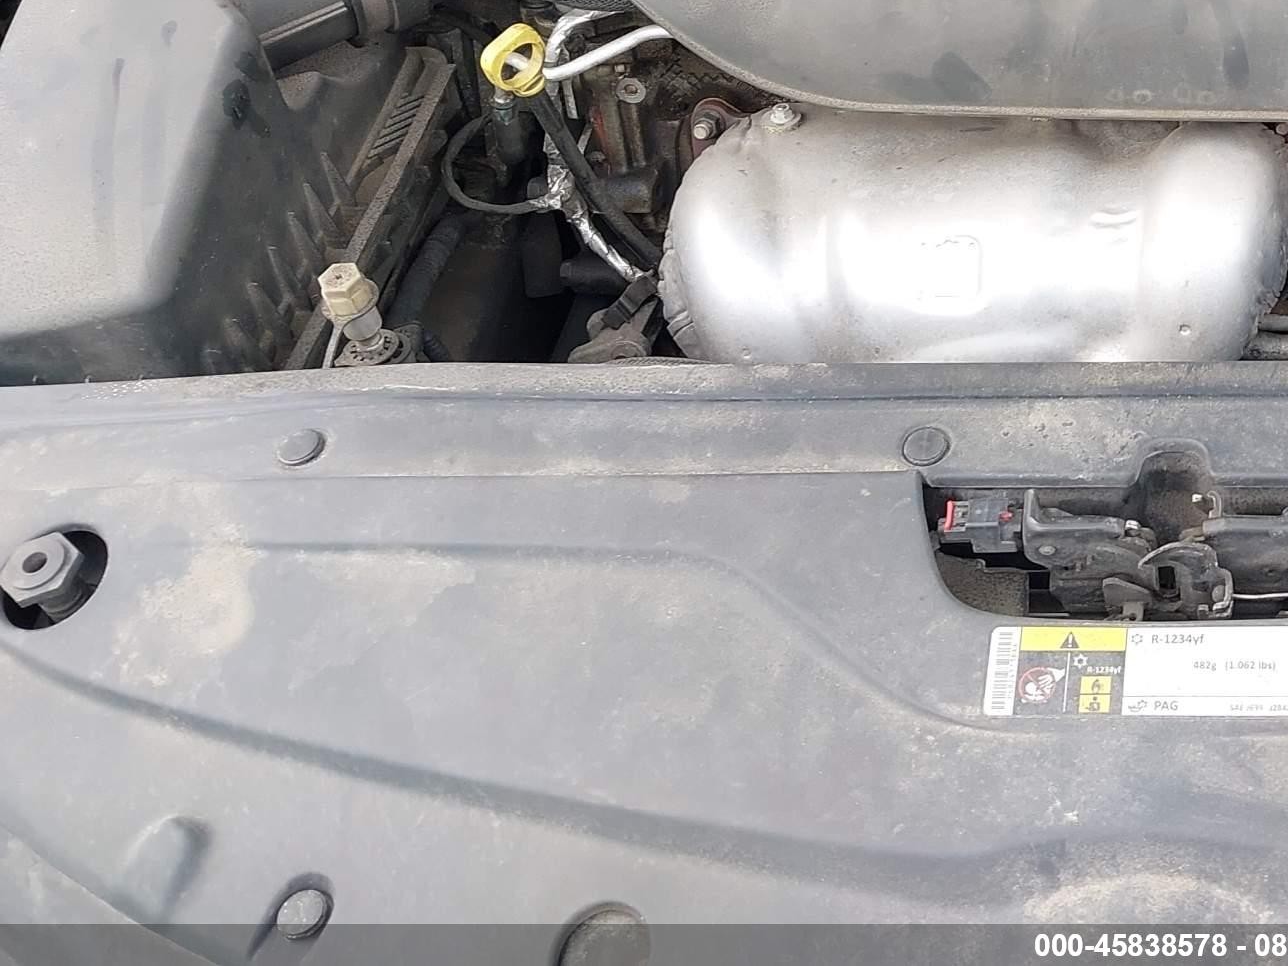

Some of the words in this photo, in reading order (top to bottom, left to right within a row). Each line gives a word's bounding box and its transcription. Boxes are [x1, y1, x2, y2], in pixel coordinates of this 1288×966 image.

[1151, 633, 1204, 645] R-1234yf
[1193, 660, 1217, 671] 482g
[1259, 660, 1277, 671] lbs)
[1154, 700, 1179, 711] PAG
